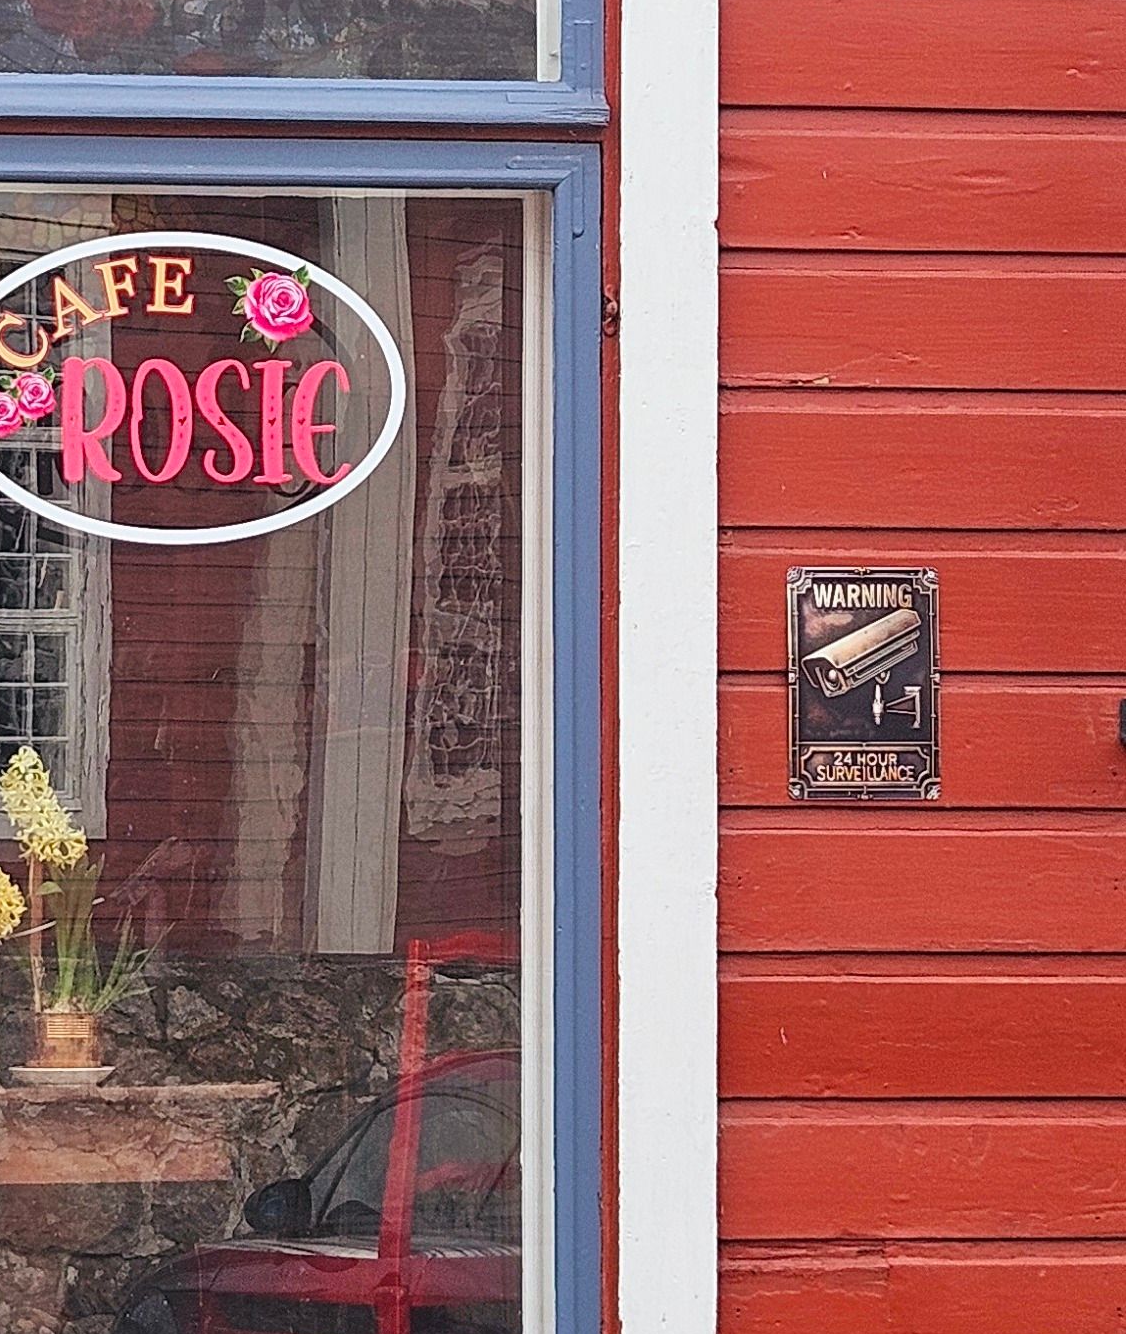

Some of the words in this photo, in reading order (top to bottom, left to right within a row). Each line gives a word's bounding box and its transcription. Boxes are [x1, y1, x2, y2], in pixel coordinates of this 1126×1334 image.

[60, 356, 352, 485] ROSIE
[813, 583, 913, 608] WARNING
[833, 752, 852, 766] 24
[856, 752, 898, 766] HOUR
[816, 765, 915, 782] SURVEILLANCE
